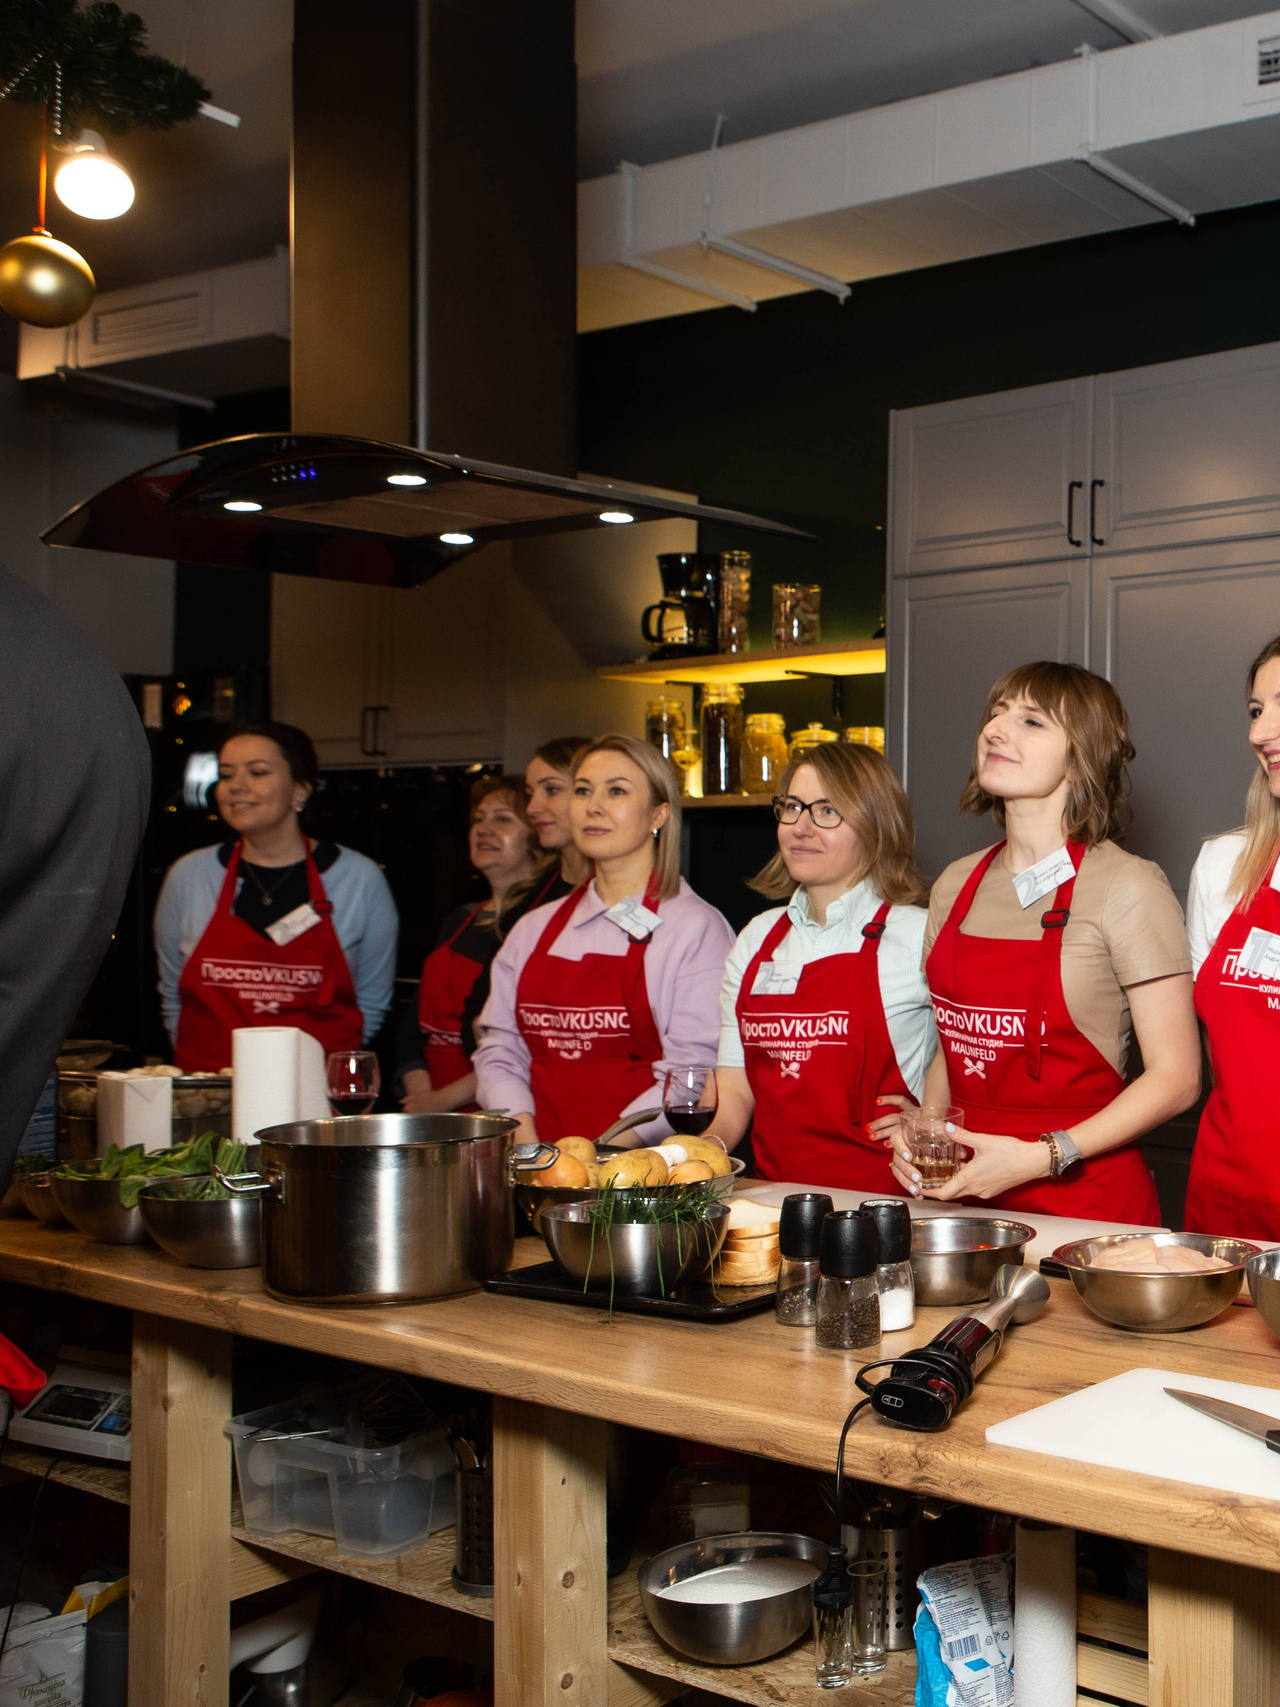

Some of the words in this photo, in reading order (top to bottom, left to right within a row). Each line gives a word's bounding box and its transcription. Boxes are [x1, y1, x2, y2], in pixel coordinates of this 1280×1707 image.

[1246, 932, 1271, 973] 1
[951, 1040, 997, 1062] MAUNFELD
[978, 1036, 1005, 1049] СТУДИЯ
